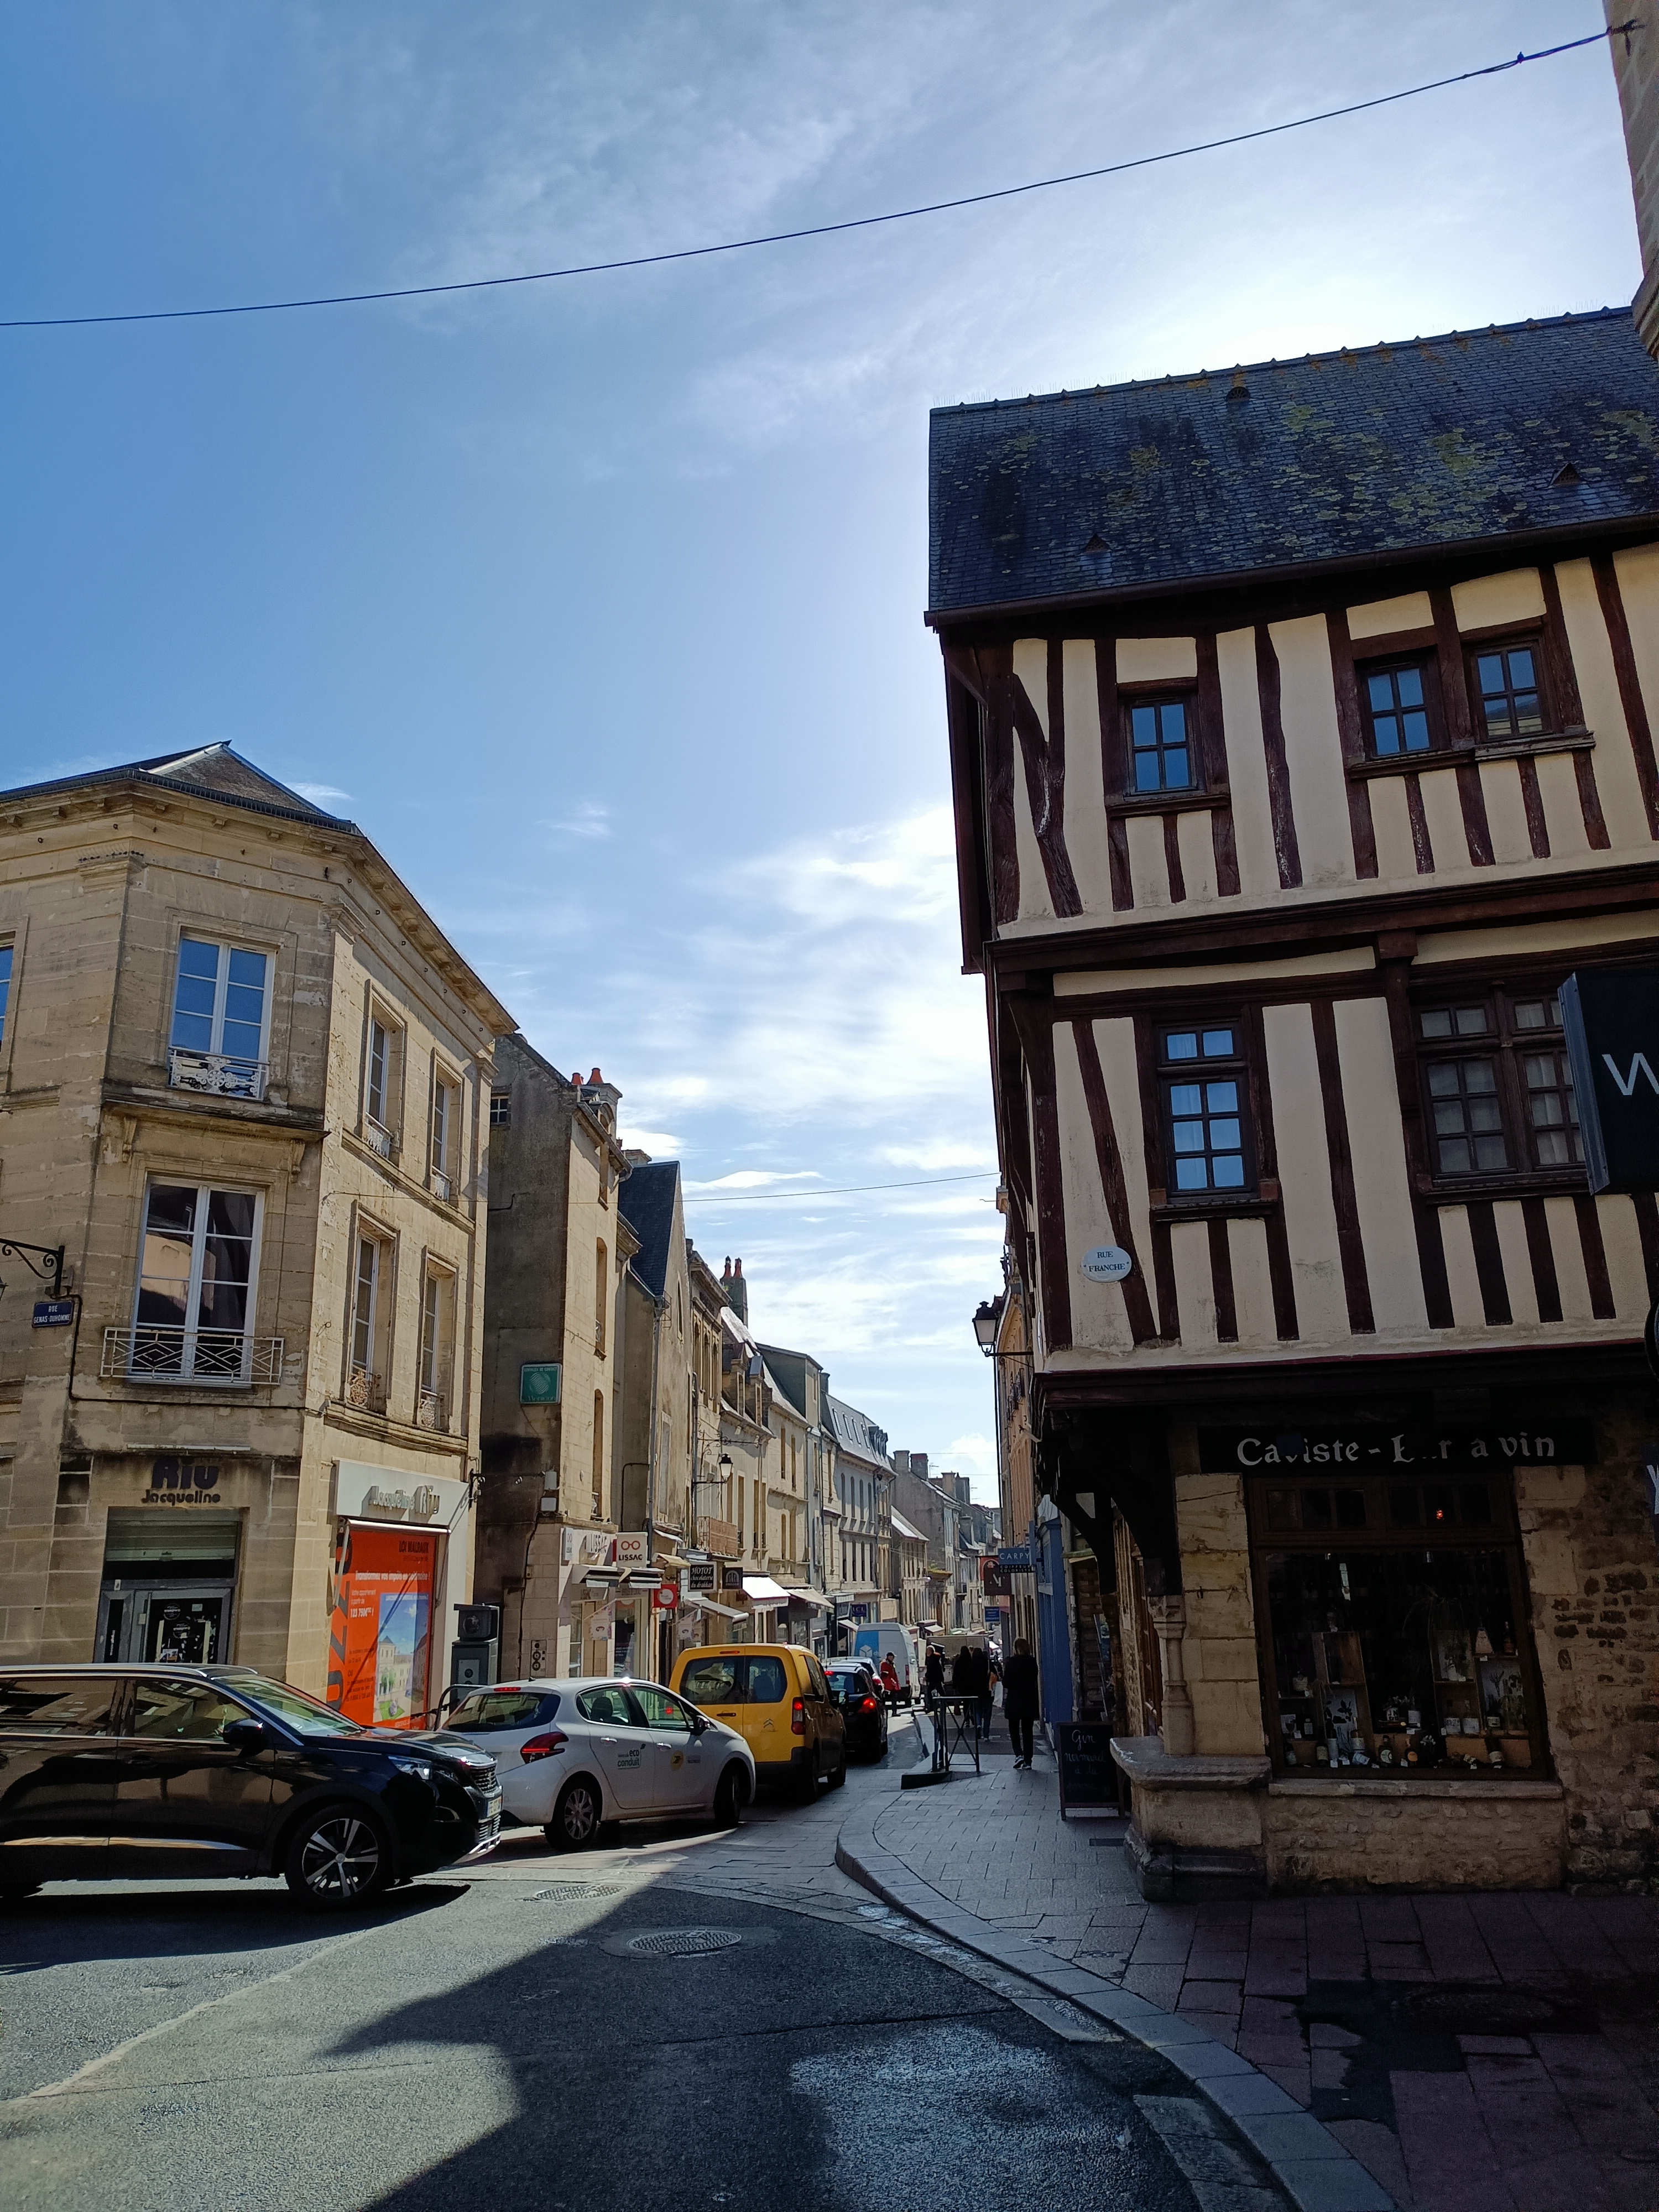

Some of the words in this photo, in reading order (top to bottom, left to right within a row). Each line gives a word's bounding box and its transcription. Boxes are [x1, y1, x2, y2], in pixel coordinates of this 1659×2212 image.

[1088, 1263, 1125, 1272] FRANCHE
[1237, 1437, 1359, 1467] Caiste
[1499, 1432, 1556, 1458] vin
[141, 1489, 221, 1506] Jacqueline
[369, 1485, 415, 1510] Jacqueline
[1071, 1729, 1097, 1751] Gin
[617, 1757, 640, 1767] conduit
[1064, 1750, 1107, 1762] normand
[1086, 1764, 1100, 1775] la
